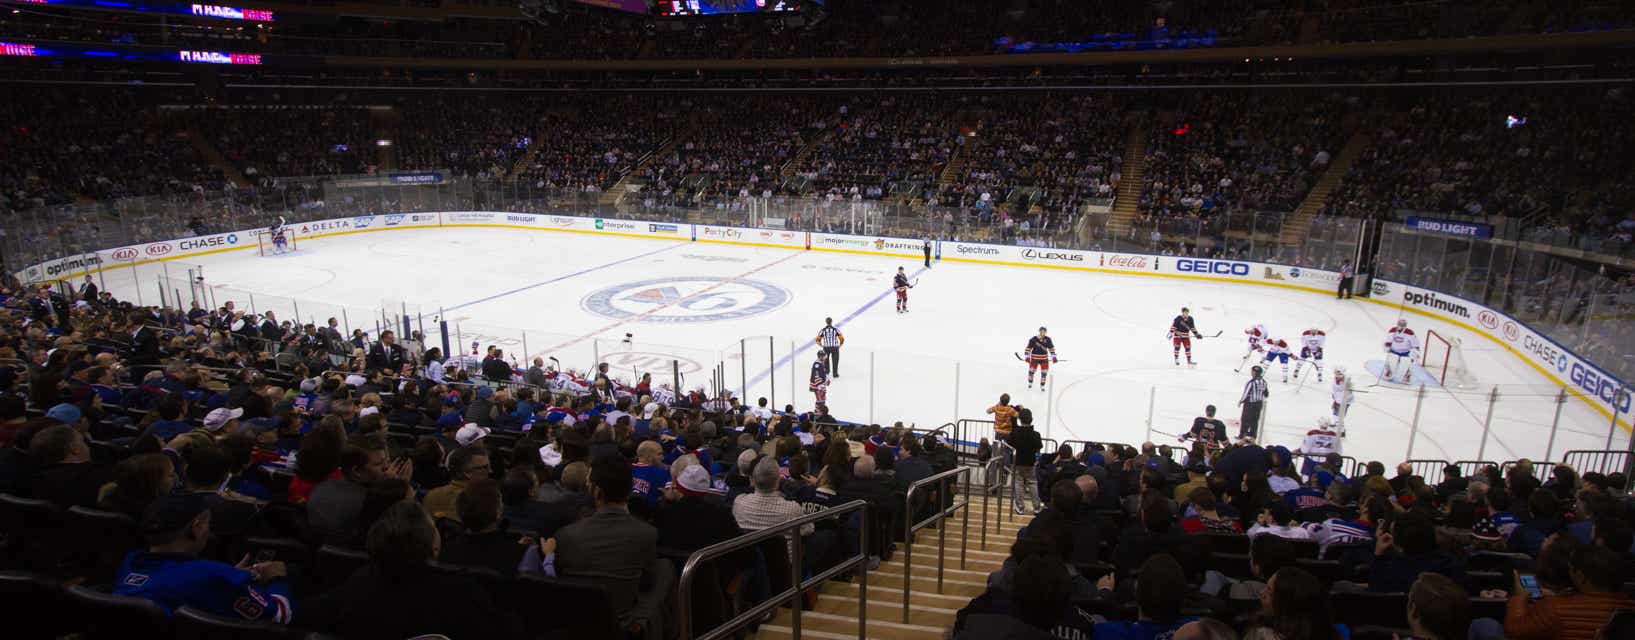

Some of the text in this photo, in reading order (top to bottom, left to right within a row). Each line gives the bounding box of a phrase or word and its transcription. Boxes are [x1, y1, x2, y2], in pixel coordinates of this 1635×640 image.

[312, 221, 349, 231] DELTA
[1417, 220, 1477, 235] BUD LIGHT
[180, 236, 225, 250] CHASE
[885, 243, 926, 251] DRAFTKING
[956, 245, 998, 256] Spectrum
[1038, 252, 1083, 261] LEXUS
[1176, 259, 1249, 276] GEICO
[1523, 334, 1557, 366] CHASE
[1570, 362, 1631, 414] GEICO
